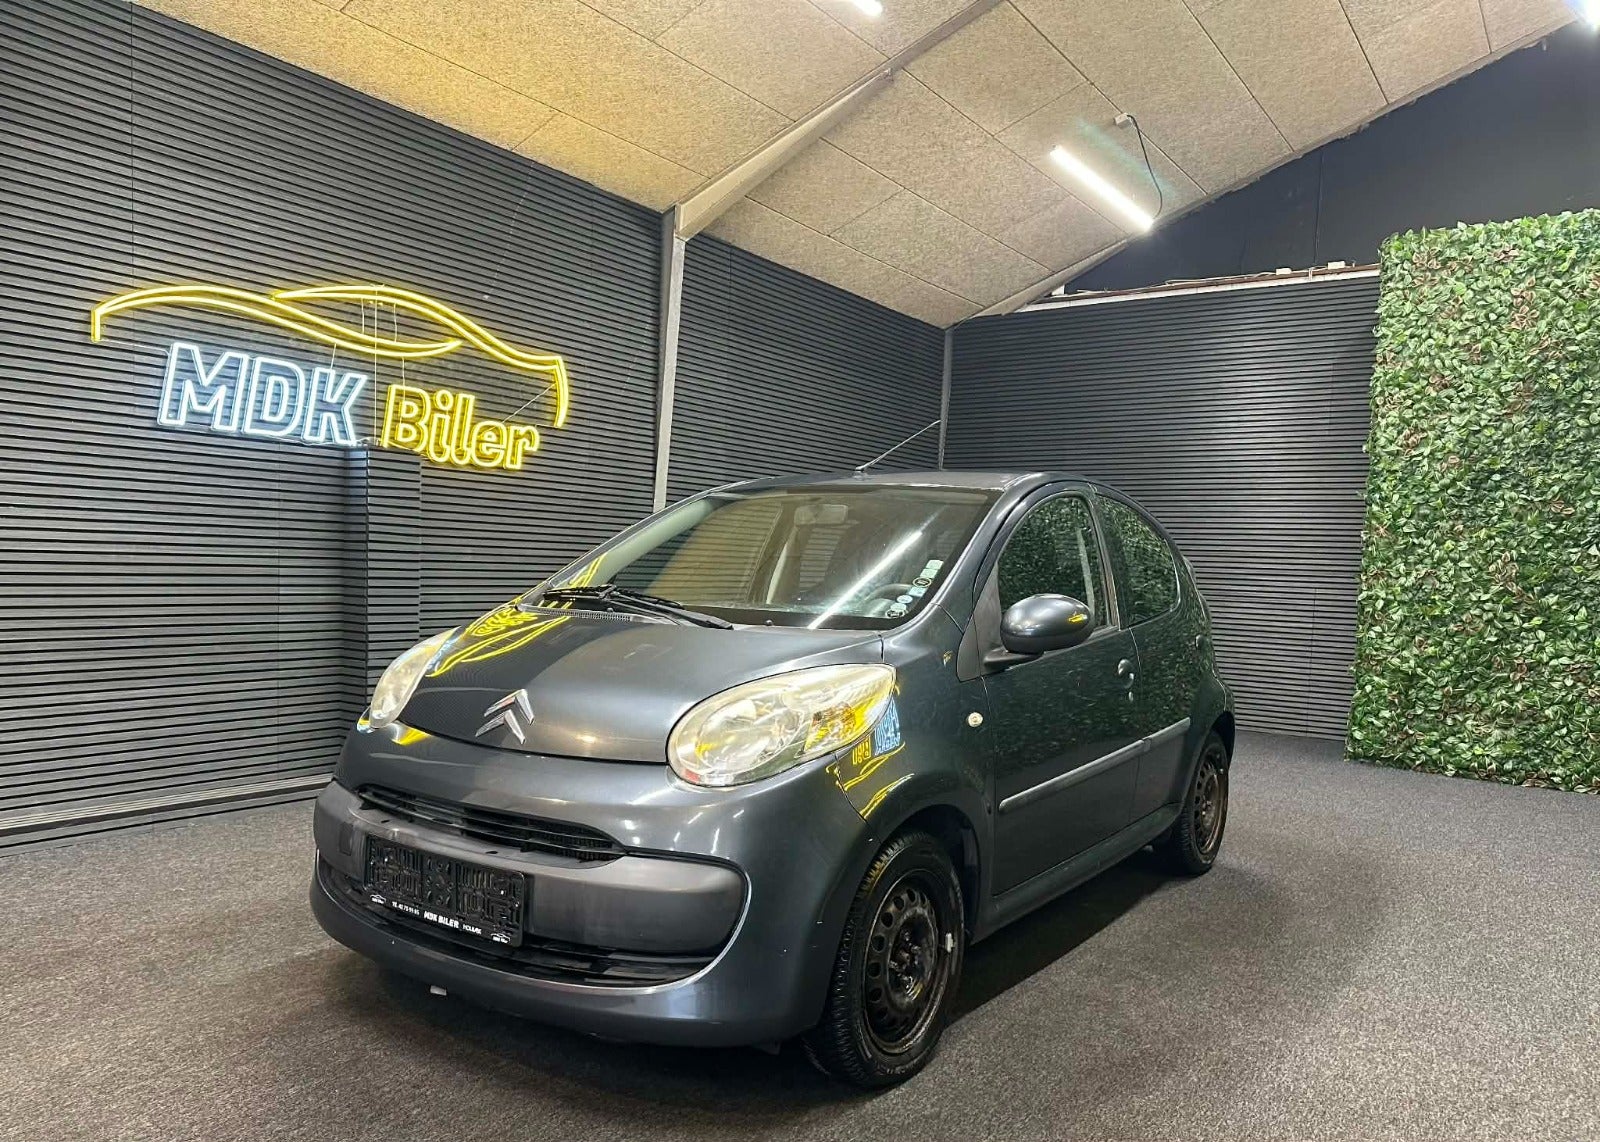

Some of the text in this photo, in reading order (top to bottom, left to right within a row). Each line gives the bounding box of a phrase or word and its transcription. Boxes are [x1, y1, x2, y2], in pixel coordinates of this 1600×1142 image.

[157, 342, 541, 471] MDK Biler
[438, 915, 459, 928] BILER
